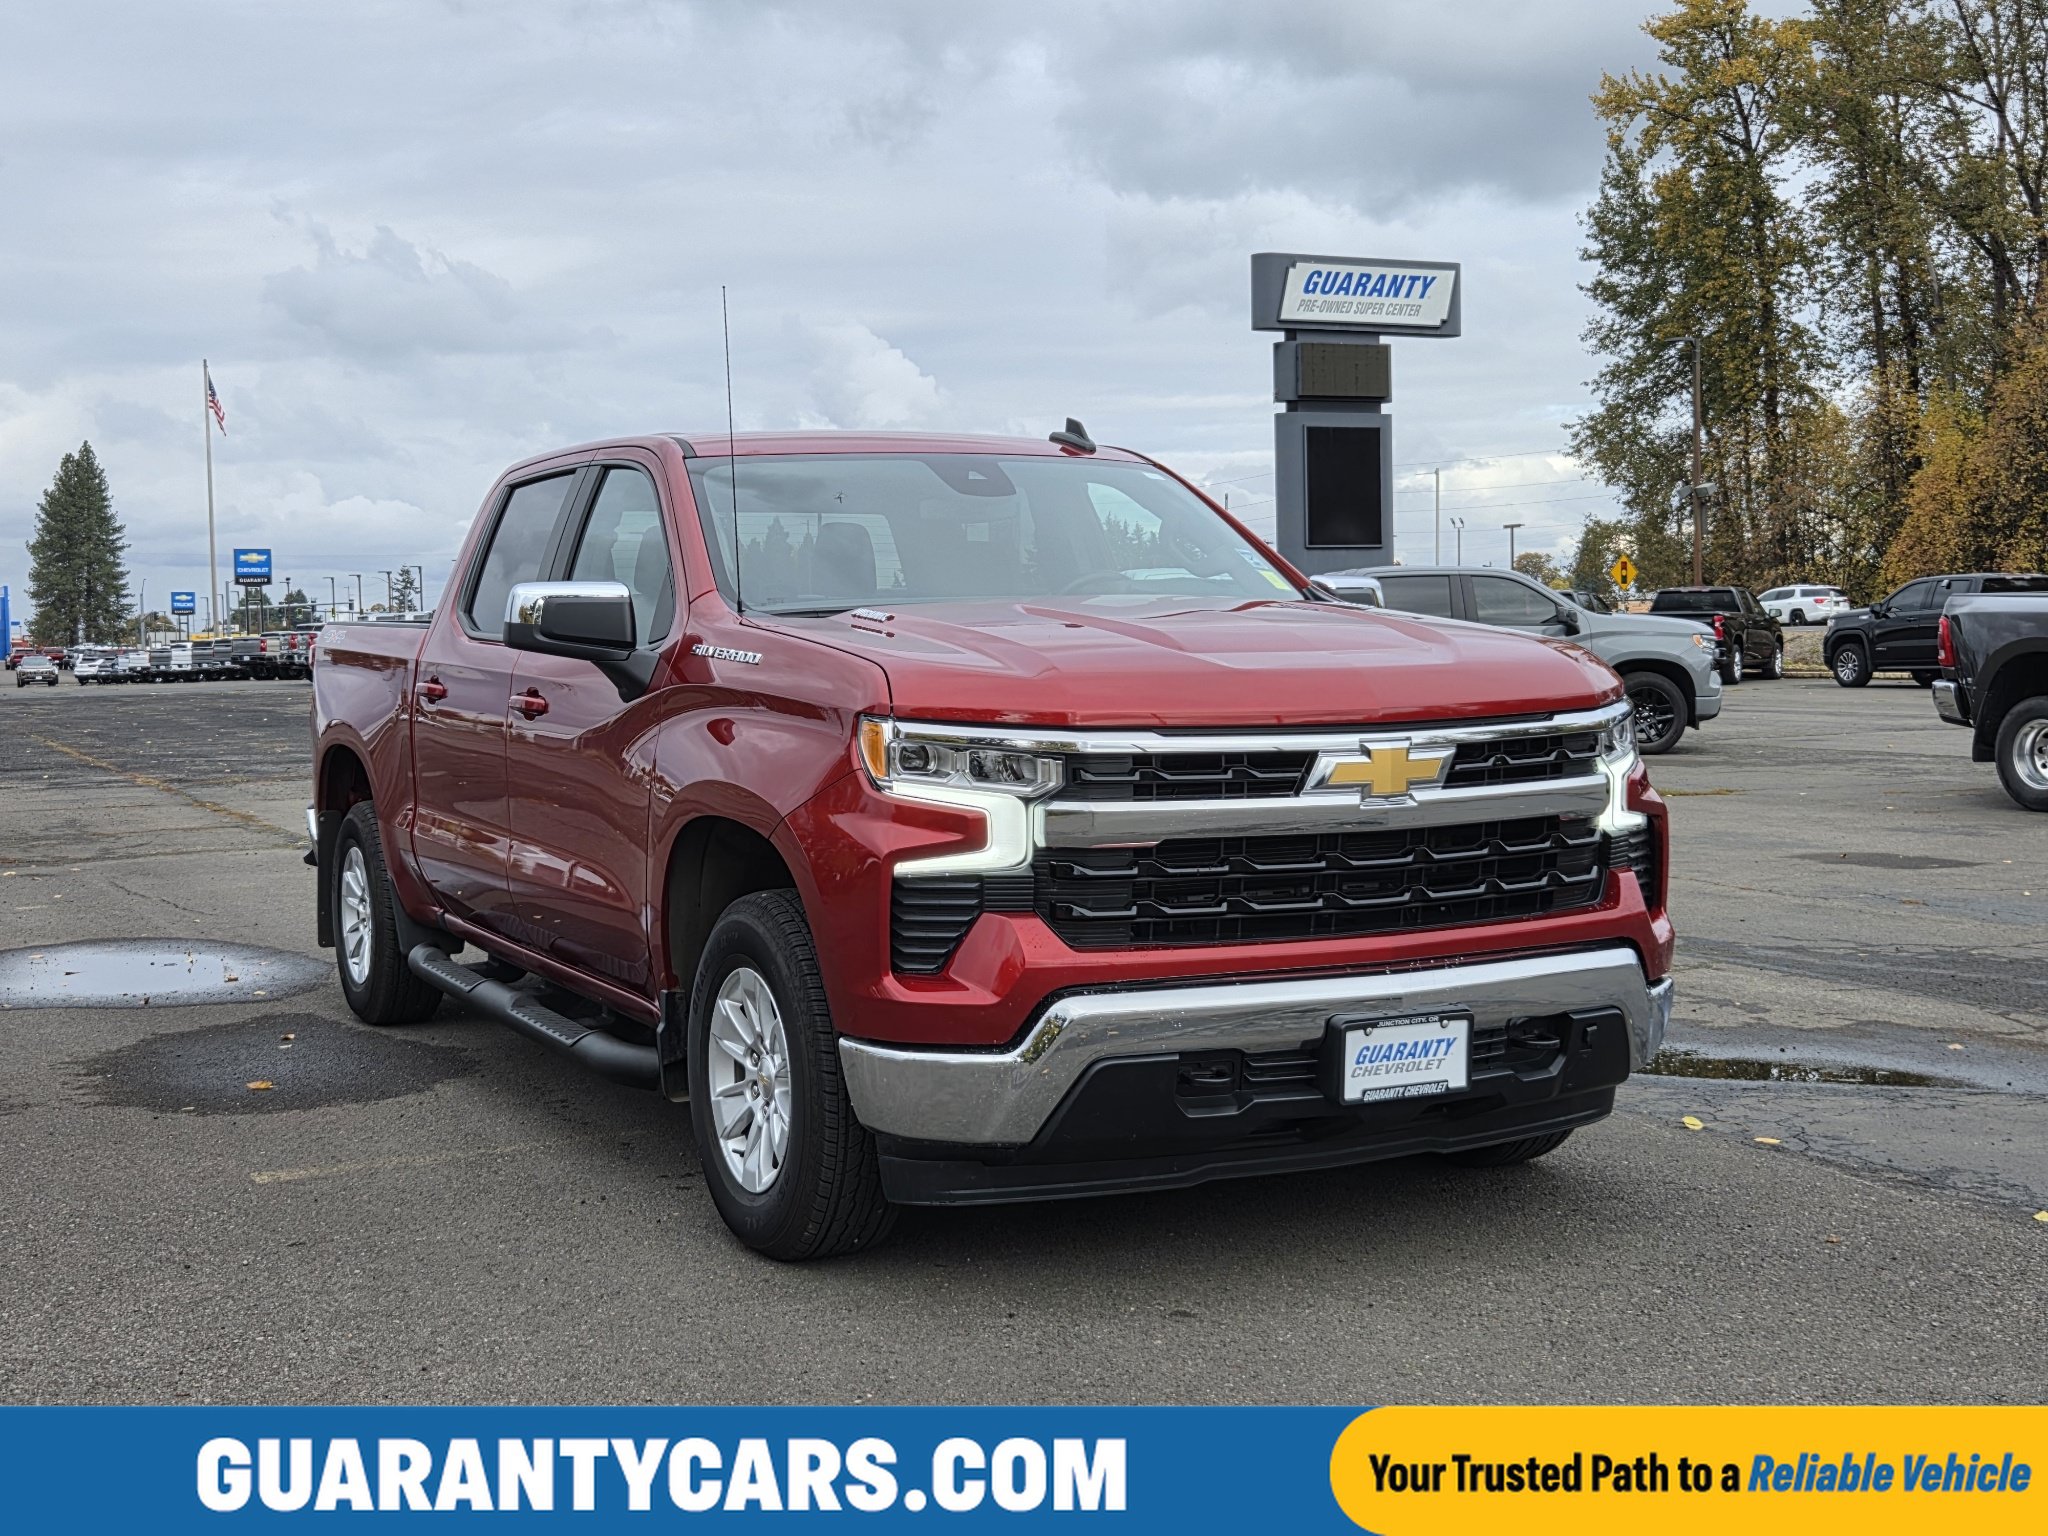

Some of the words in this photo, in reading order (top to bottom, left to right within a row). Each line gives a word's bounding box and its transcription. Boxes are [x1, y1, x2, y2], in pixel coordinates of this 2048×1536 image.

[1303, 270, 1437, 299] GUARANTY
[1297, 299, 1354, 314] PRE-OWNED
[1354, 301, 1384, 315] SUPER
[1385, 304, 1422, 317] CENTER
[691, 643, 762, 665] SILVERADO
[1377, 1019, 1410, 1027] JUNCTION
[1355, 1037, 1458, 1065] GUARANTY
[1351, 1058, 1445, 1078] CHEVROLET
[1364, 1087, 1403, 1101] GUARANTY
[1404, 1082, 1448, 1096] CHEVROLET
